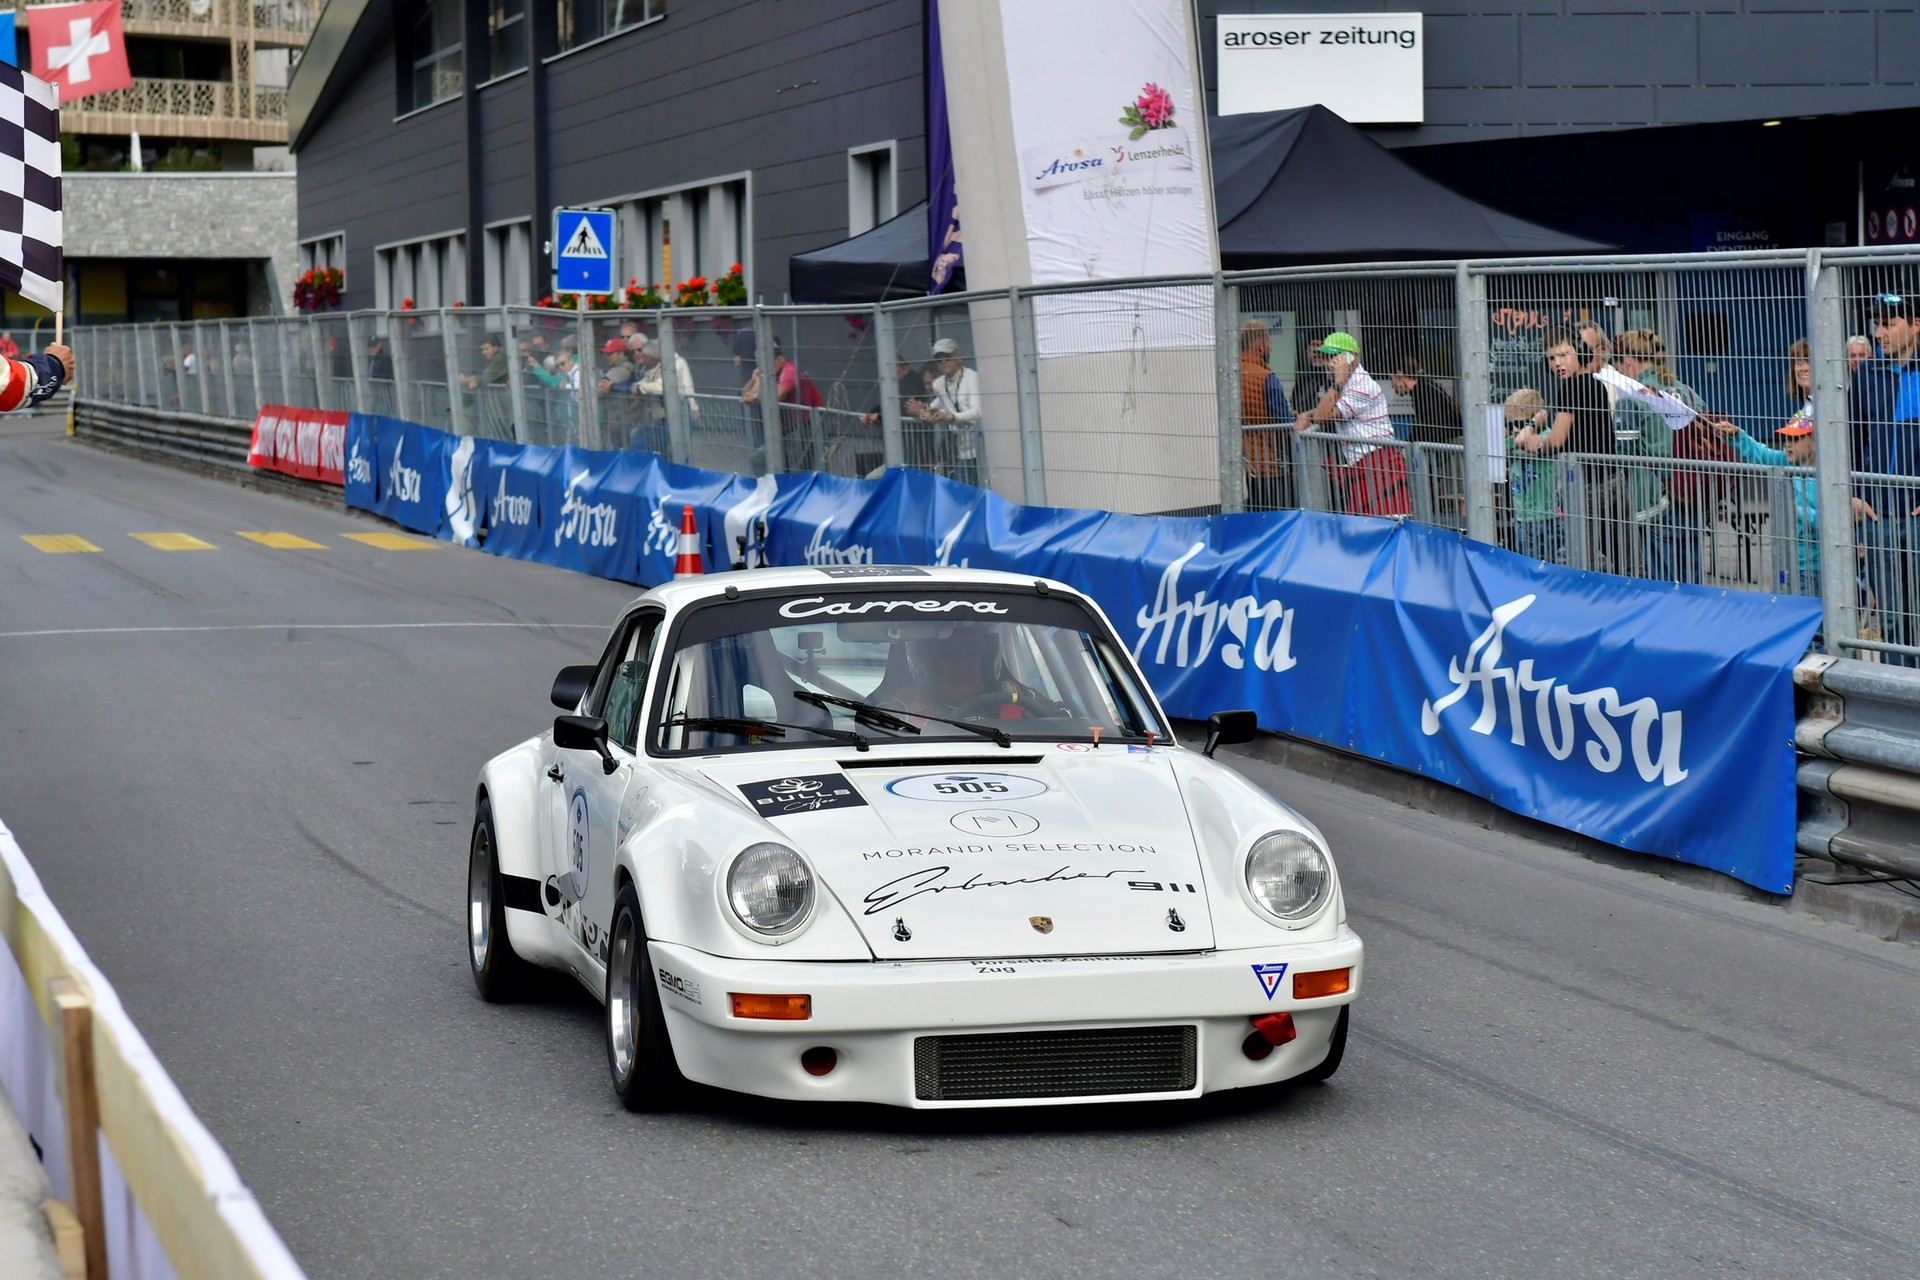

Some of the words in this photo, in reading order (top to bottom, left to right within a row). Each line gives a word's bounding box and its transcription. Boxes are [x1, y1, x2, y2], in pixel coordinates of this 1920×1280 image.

[1224, 31, 1310, 46] aroser
[1320, 27, 1415, 48] zeitung
[1128, 144, 1185, 161] Lenzerheide
[1036, 157, 1103, 180] Arosa
[1716, 230, 1768, 242] EINGANG
[555, 468, 617, 547] Arosa
[778, 596, 1009, 618] Carrera
[1132, 542, 1297, 673] Arosa
[1421, 594, 1689, 787] Arosa
[932, 782, 1009, 794] 505
[757, 789, 851, 805] BULLS
[862, 845, 992, 861] MORANDI
[1006, 843, 1156, 854] SELECTION
[1127, 881, 1196, 893] 911
[970, 957, 1054, 966] Porsche
[975, 966, 1016, 974] Zug
